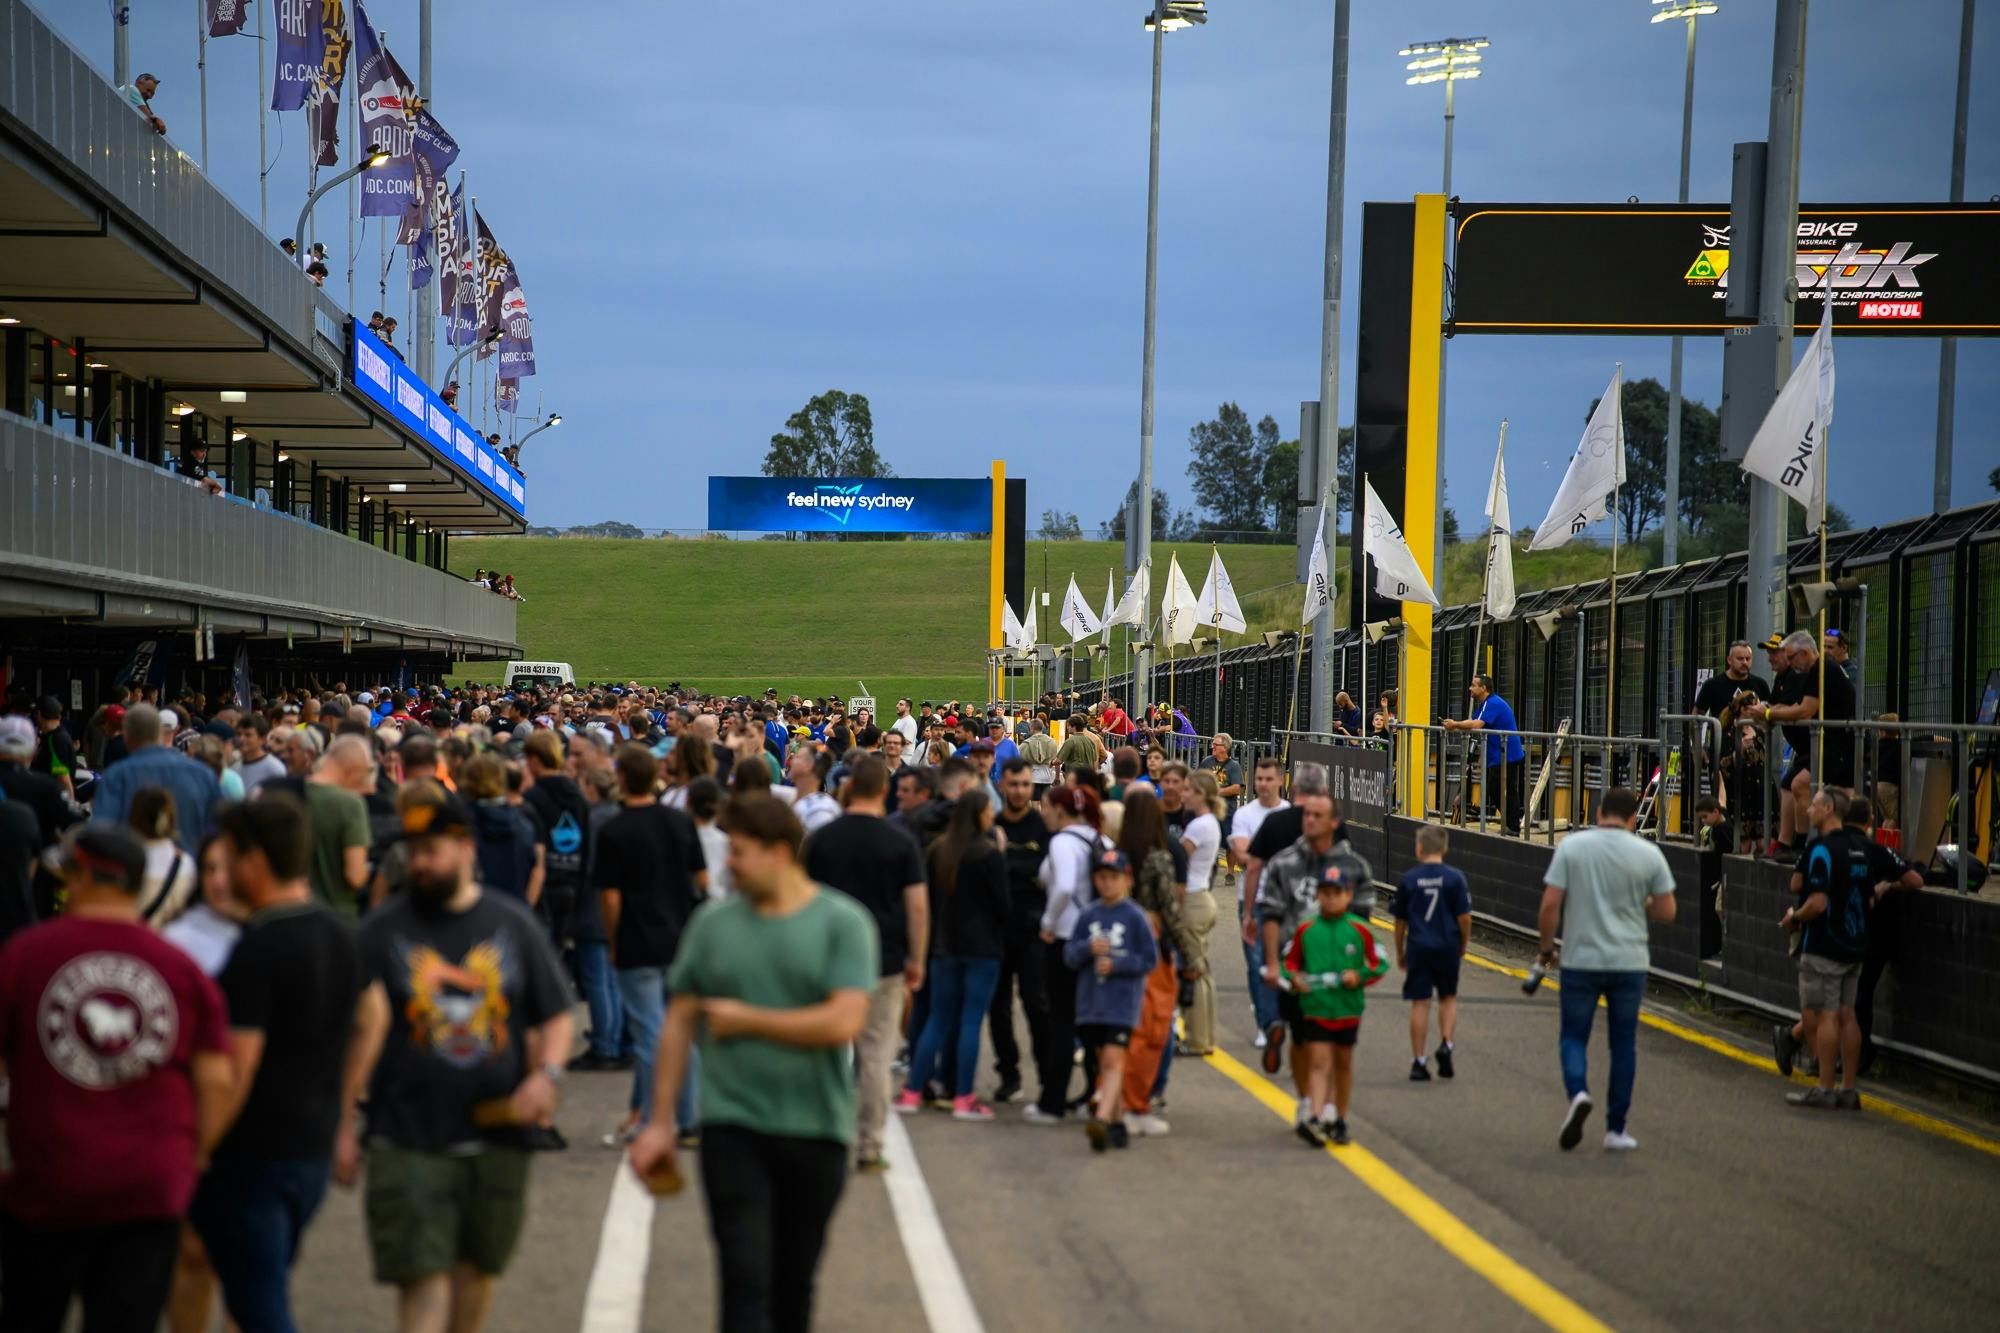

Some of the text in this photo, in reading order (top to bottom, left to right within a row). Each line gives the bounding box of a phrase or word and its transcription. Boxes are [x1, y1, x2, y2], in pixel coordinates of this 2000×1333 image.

[433, 138, 453, 154] CLUB
[1861, 303, 1921, 317] MOTUL
[787, 492, 914, 511] feel new sydney
[514, 665, 560, 675] 0418 437 897
[1424, 888, 1439, 922] 7
